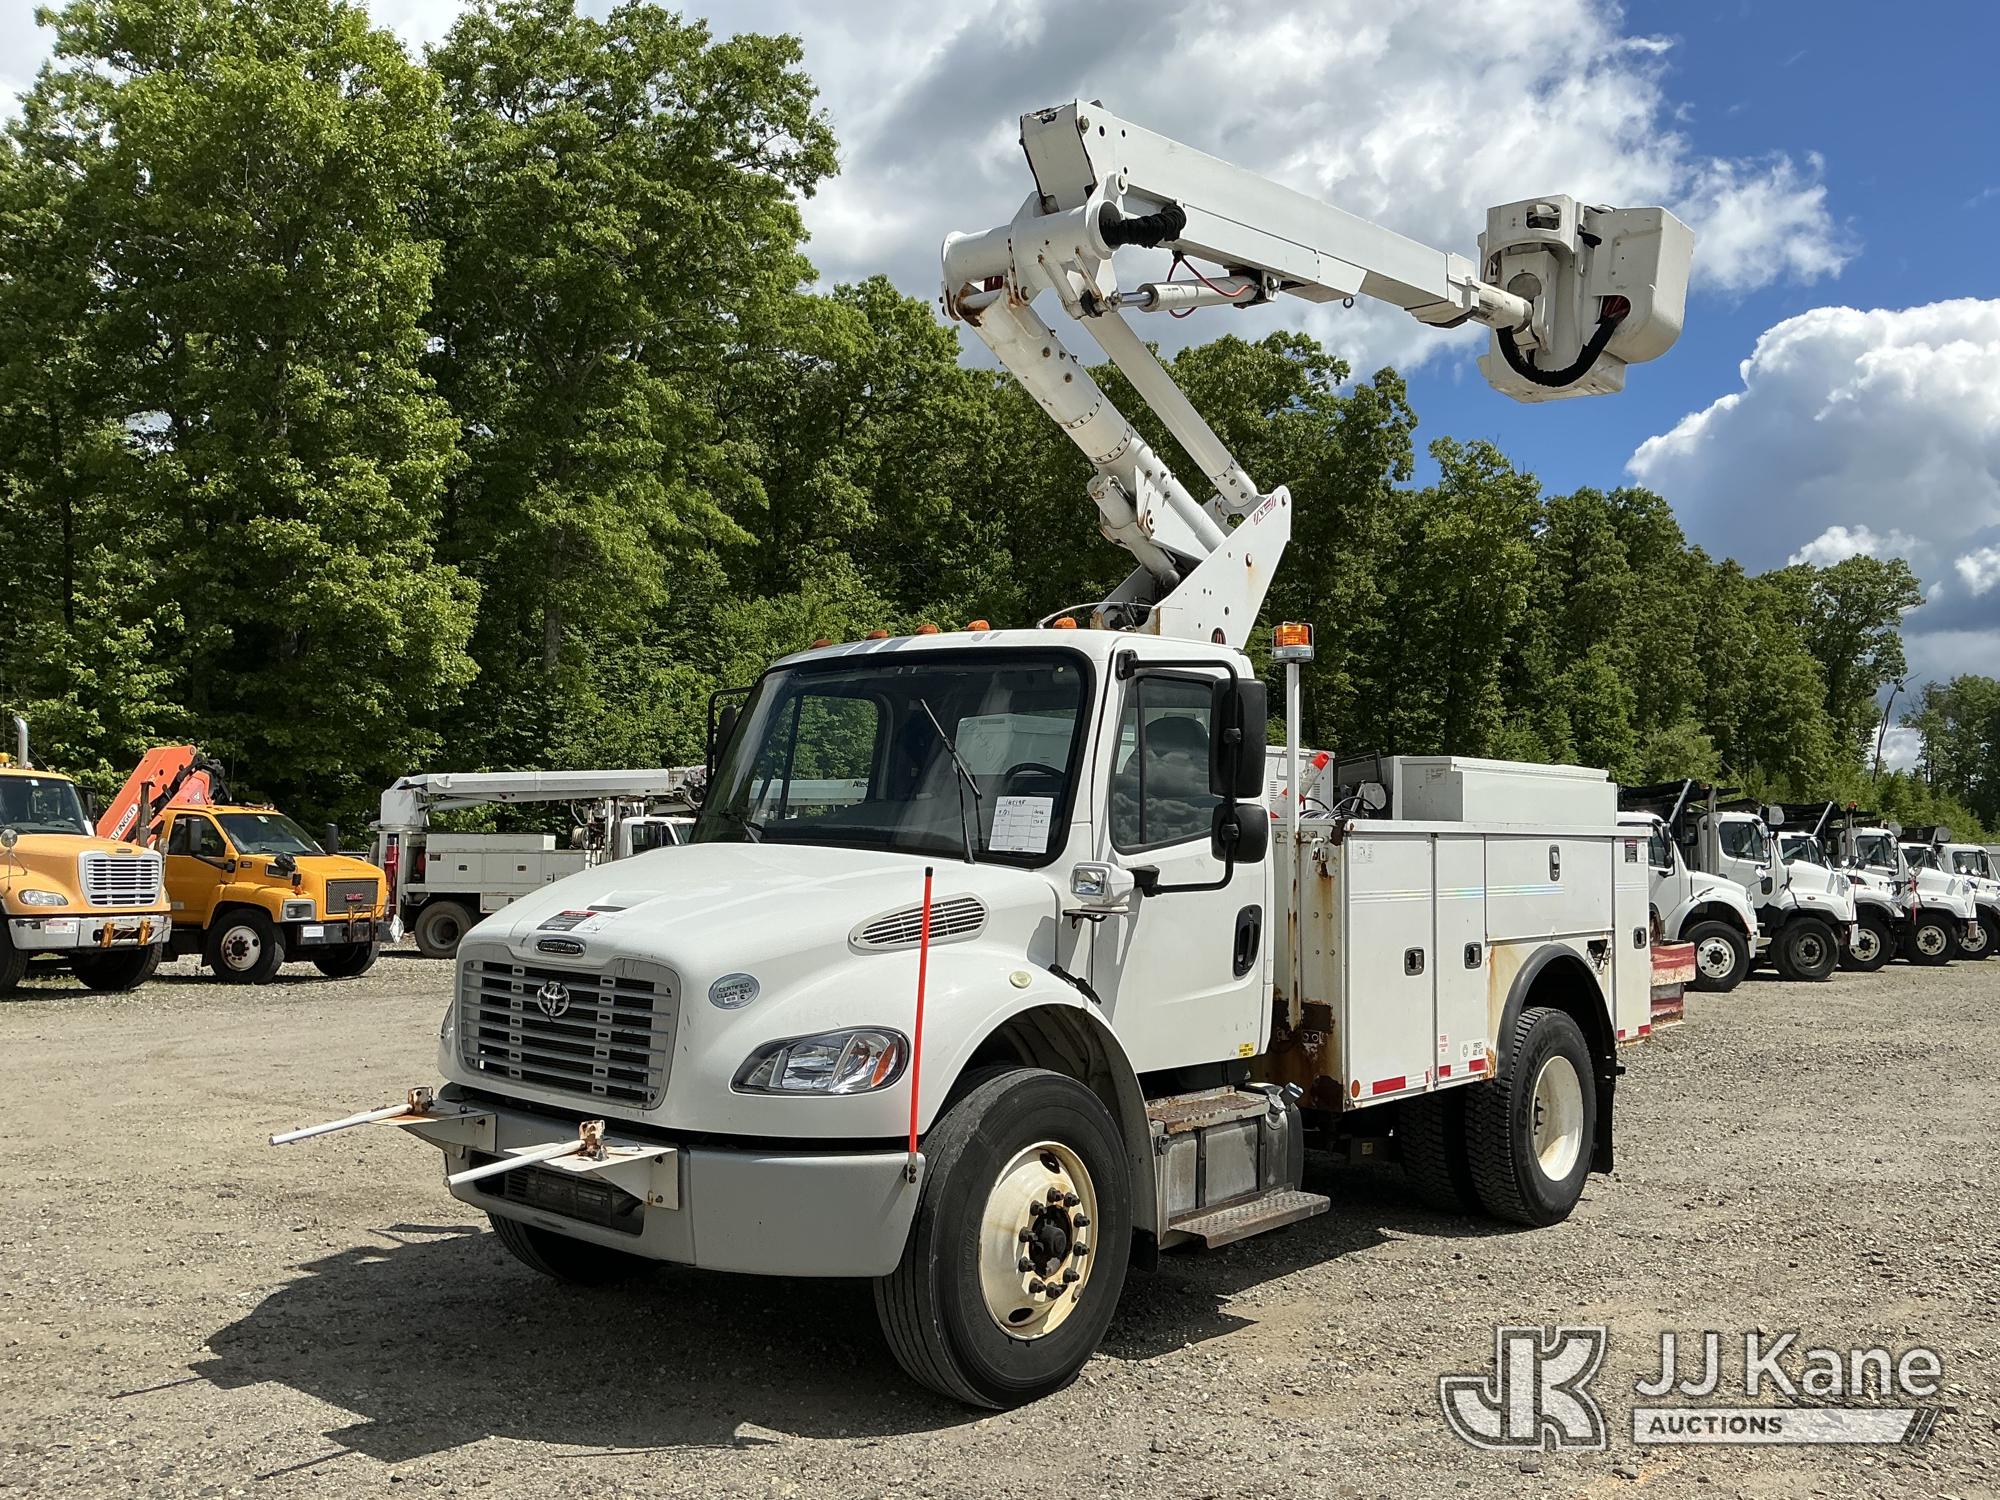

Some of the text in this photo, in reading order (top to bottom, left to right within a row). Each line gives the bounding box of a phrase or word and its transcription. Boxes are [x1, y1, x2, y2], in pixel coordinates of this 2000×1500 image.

[345, 893, 364, 901] GMC
[716, 987, 753, 999] CLEAN IDLE
[718, 982, 750, 993] CERTIFIED
